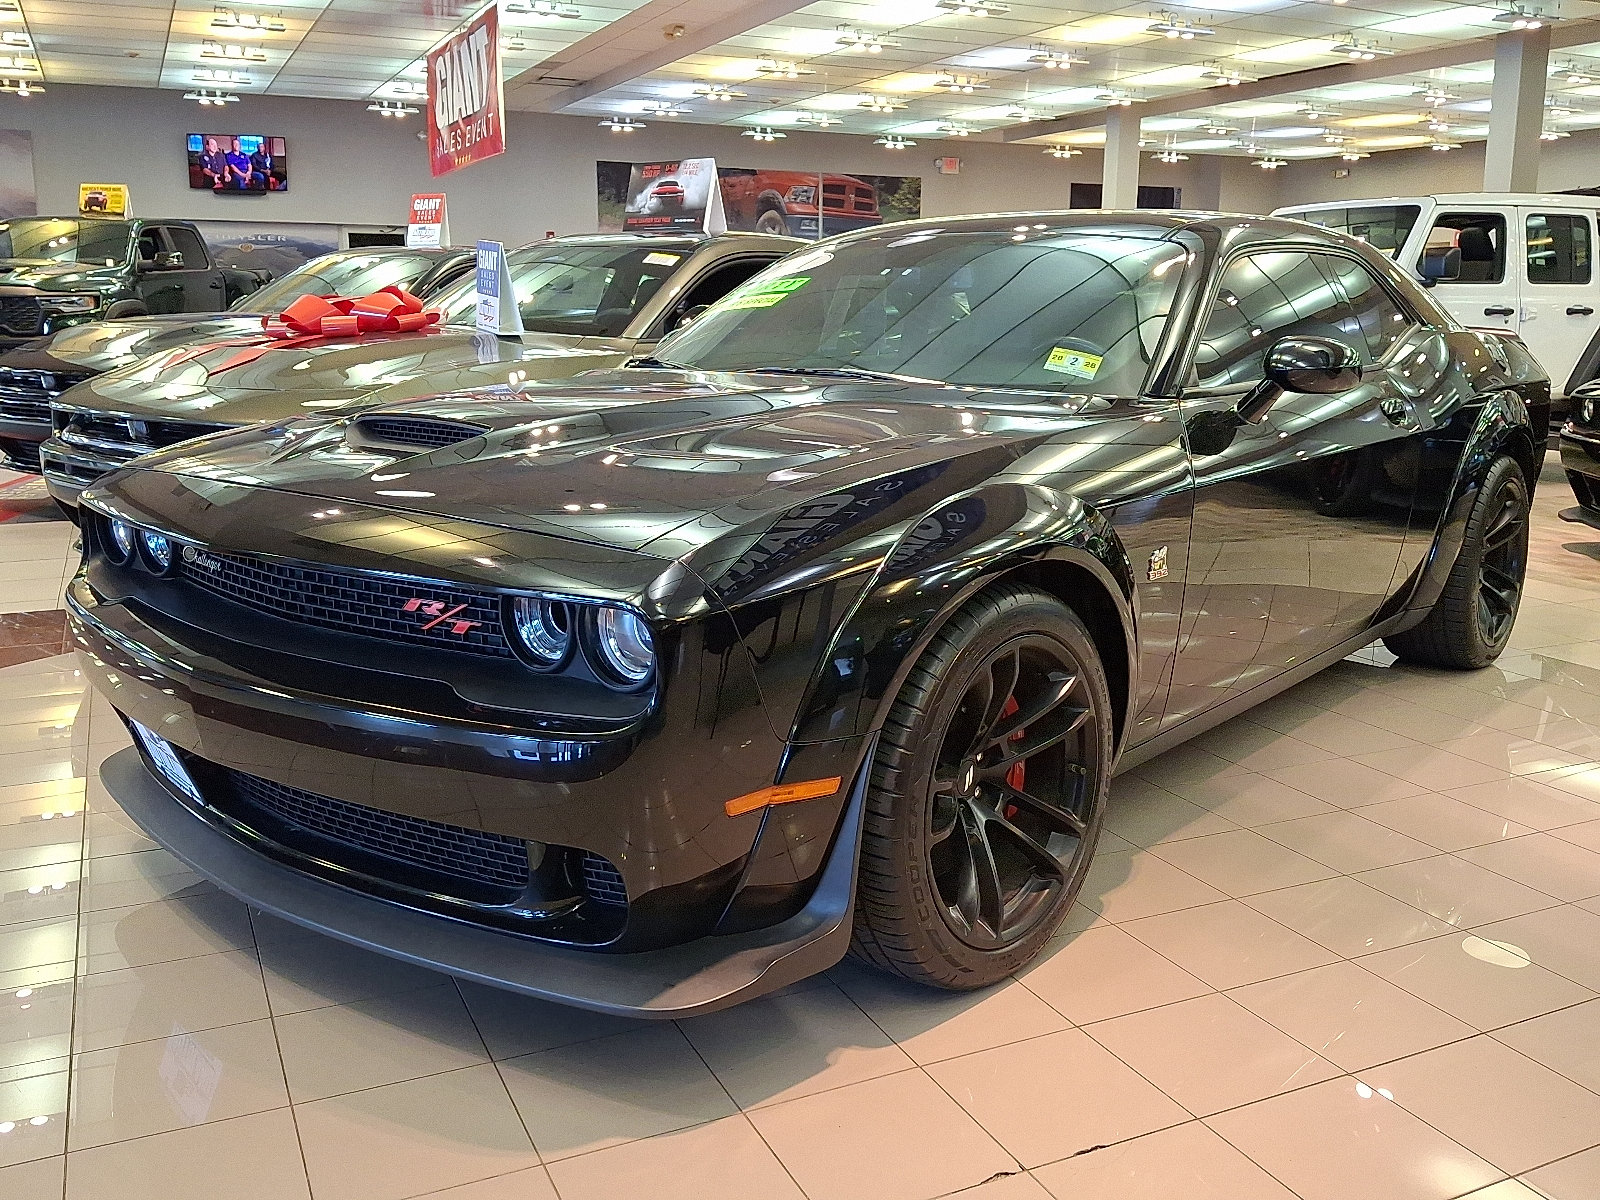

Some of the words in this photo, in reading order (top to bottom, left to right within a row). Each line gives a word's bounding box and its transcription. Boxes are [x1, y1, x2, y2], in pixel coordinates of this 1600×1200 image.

[435, 24, 489, 129] GIANT
[436, 130, 462, 159] SALES
[465, 112, 494, 147] EVENT
[414, 198, 441, 210] GIANT
[478, 249, 498, 271] GIANT
[480, 270, 495, 281] SALES
[480, 278, 495, 289] EVENT
[1069, 357, 1079, 366] 2
[1150, 569, 1169, 581] 392
[402, 597, 483, 635] R/T
